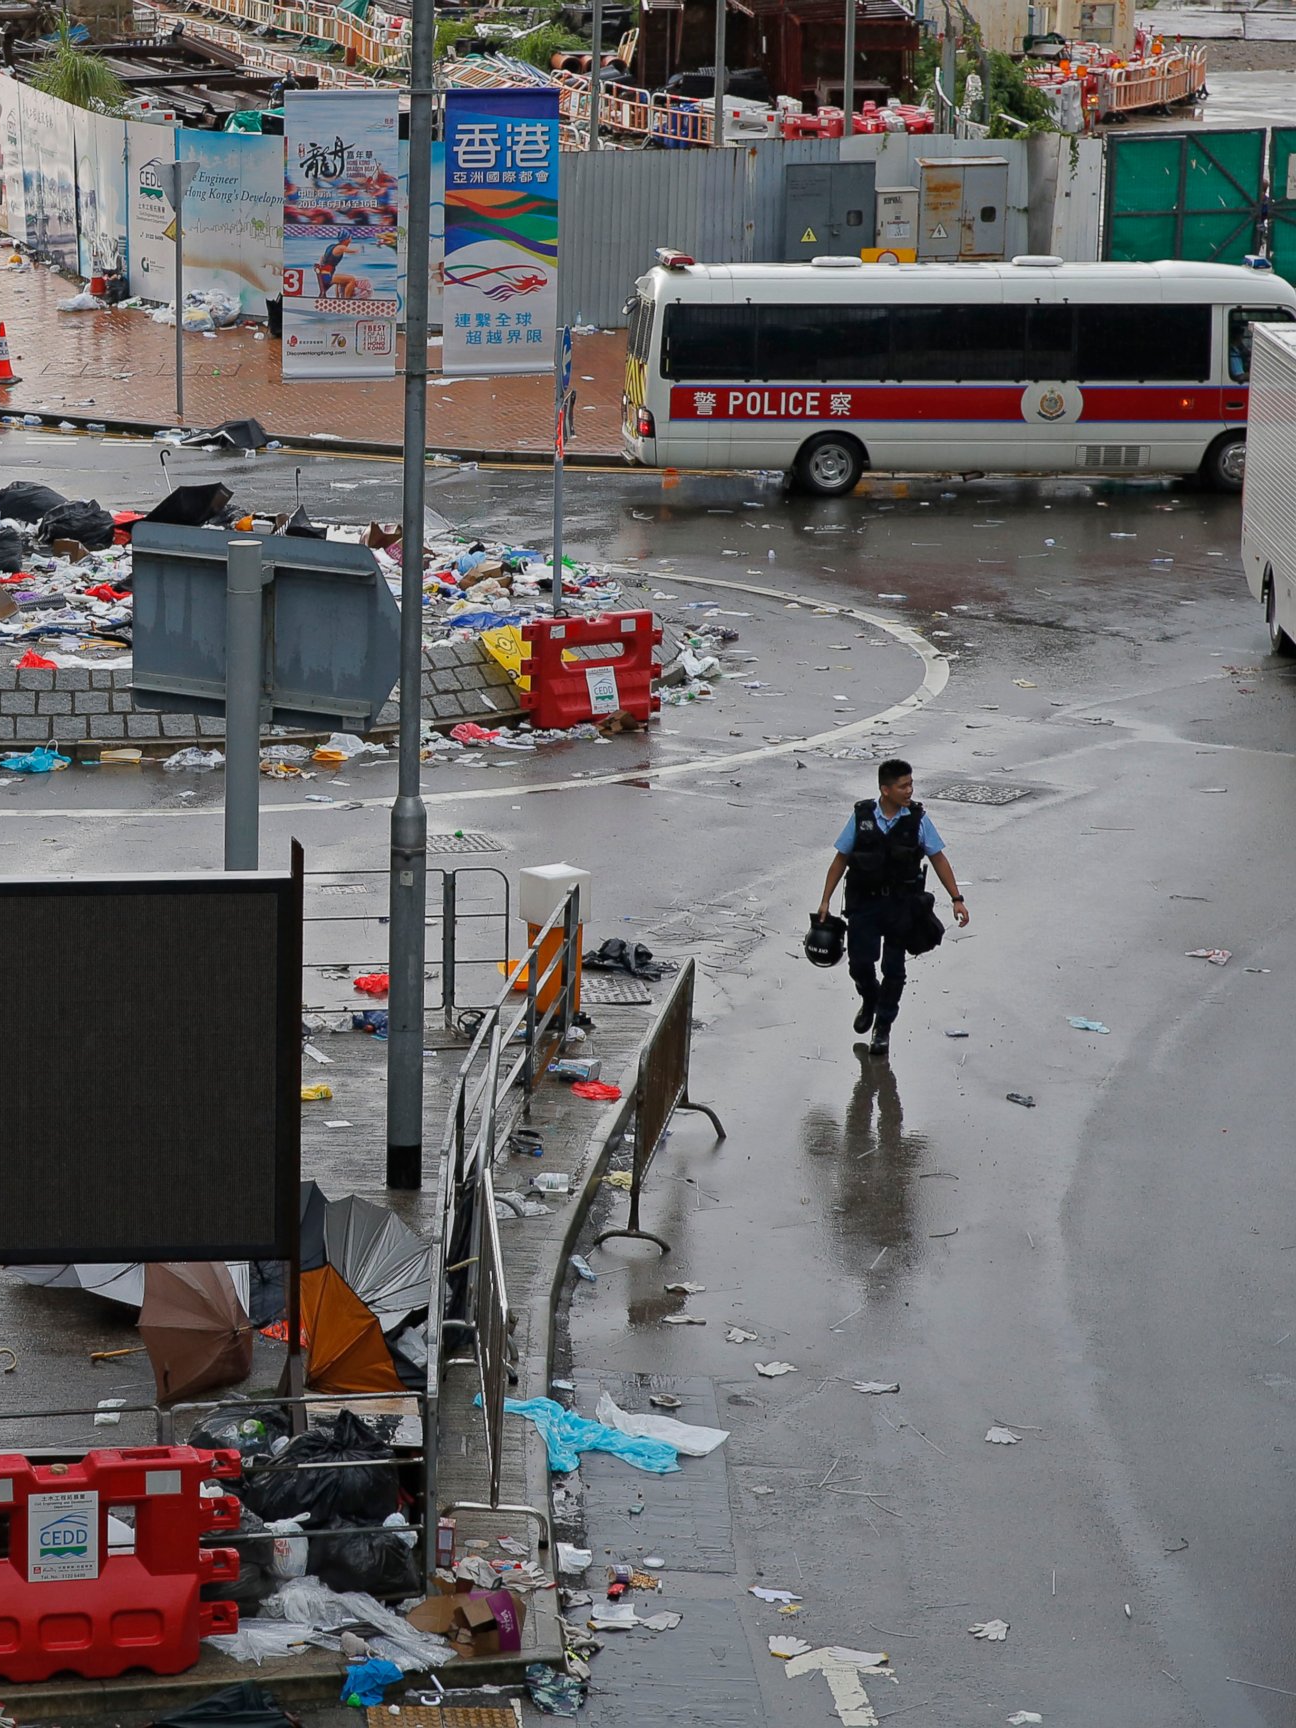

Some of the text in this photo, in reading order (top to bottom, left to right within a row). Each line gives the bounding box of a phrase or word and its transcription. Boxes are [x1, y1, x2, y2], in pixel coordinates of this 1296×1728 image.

[453, 123, 550, 168] 香港
[346, 150, 373, 160] 嘉年華
[198, 172, 239, 186] Engineer
[453, 170, 549, 184] 亞洲國際都會
[209, 188, 239, 203] Kong's
[284, 270, 300, 293] 3
[454, 312, 533, 328] 連繫全球
[465, 330, 542, 345] 超越界限
[693, 391, 852, 416] 警 POLICE 察
[594, 686, 613, 695] CEDD
[40, 1529, 88, 1546] CEDD
